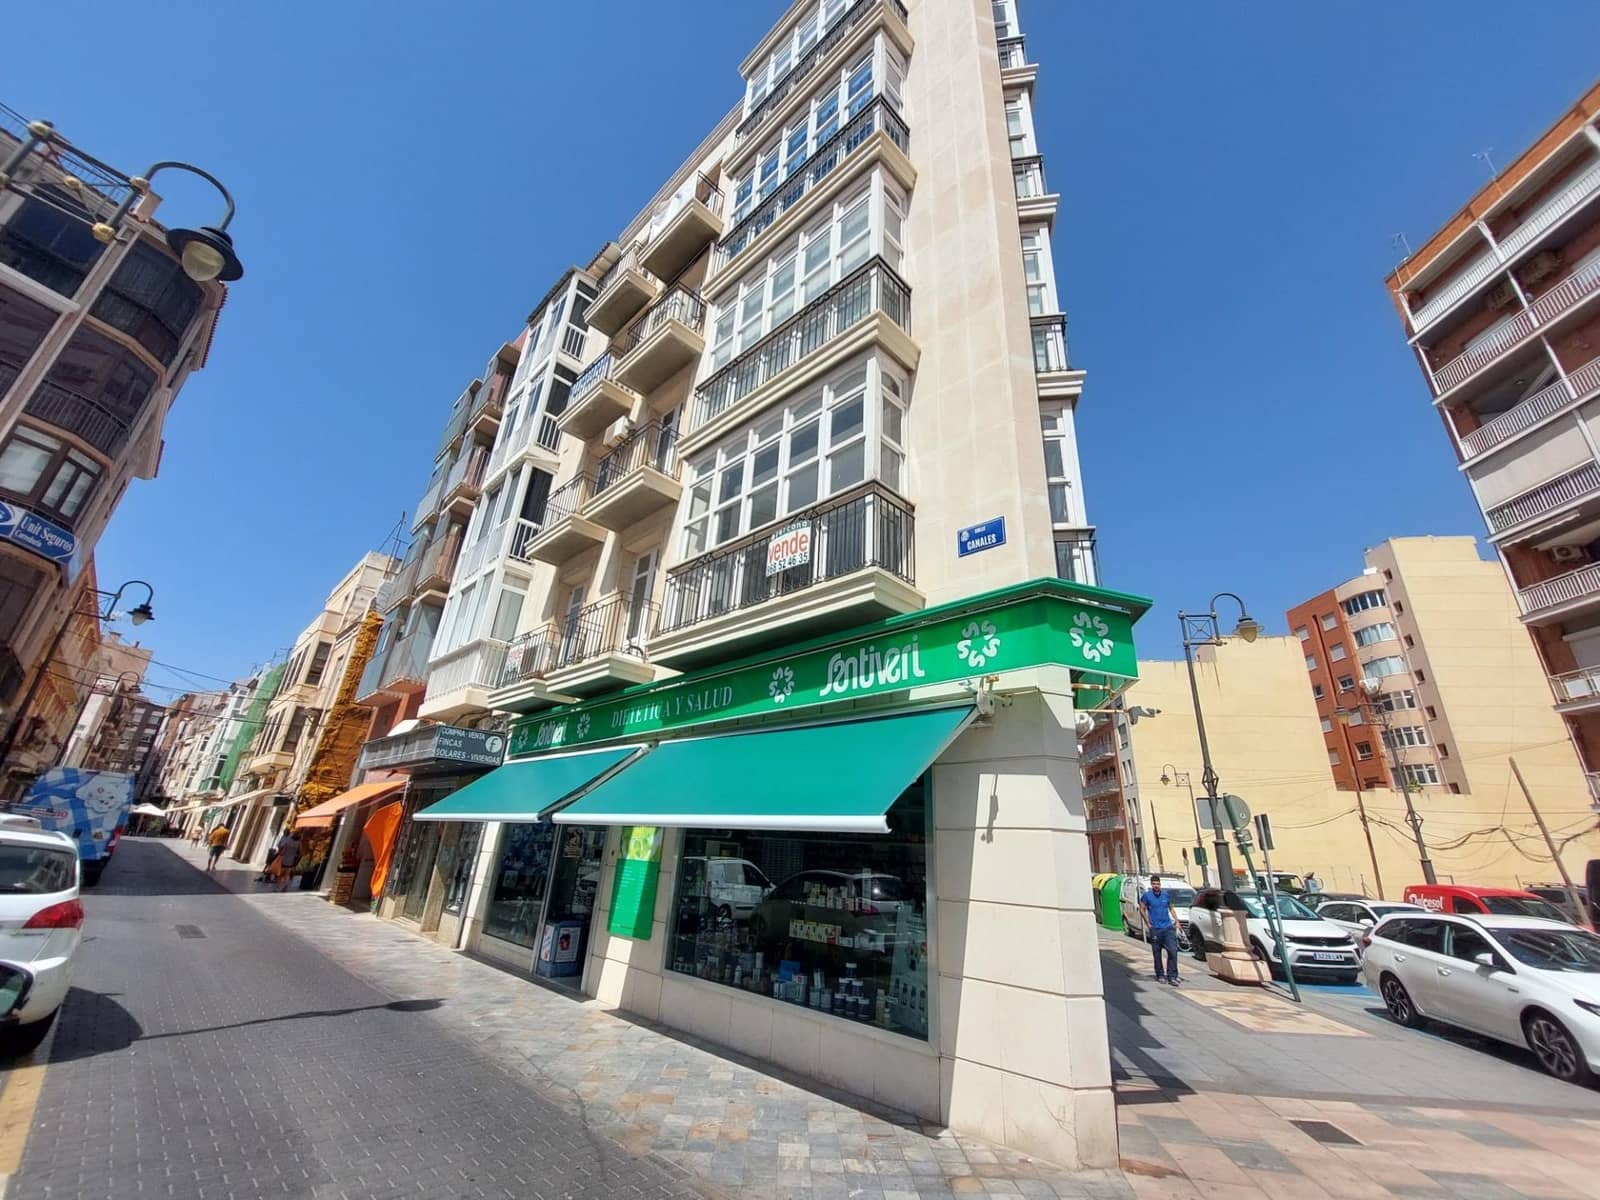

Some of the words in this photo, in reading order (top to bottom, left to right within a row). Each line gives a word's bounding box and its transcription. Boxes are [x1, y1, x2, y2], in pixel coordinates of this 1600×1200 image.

[40, 527, 73, 552] Seguros
[768, 531, 809, 564] vende
[967, 533, 997, 551] CANALES
[675, 695, 685, 716] Y
[686, 685, 733, 714] SALUD
[439, 737, 463, 748] FINCAS
[436, 748, 466, 759] SOLARES
